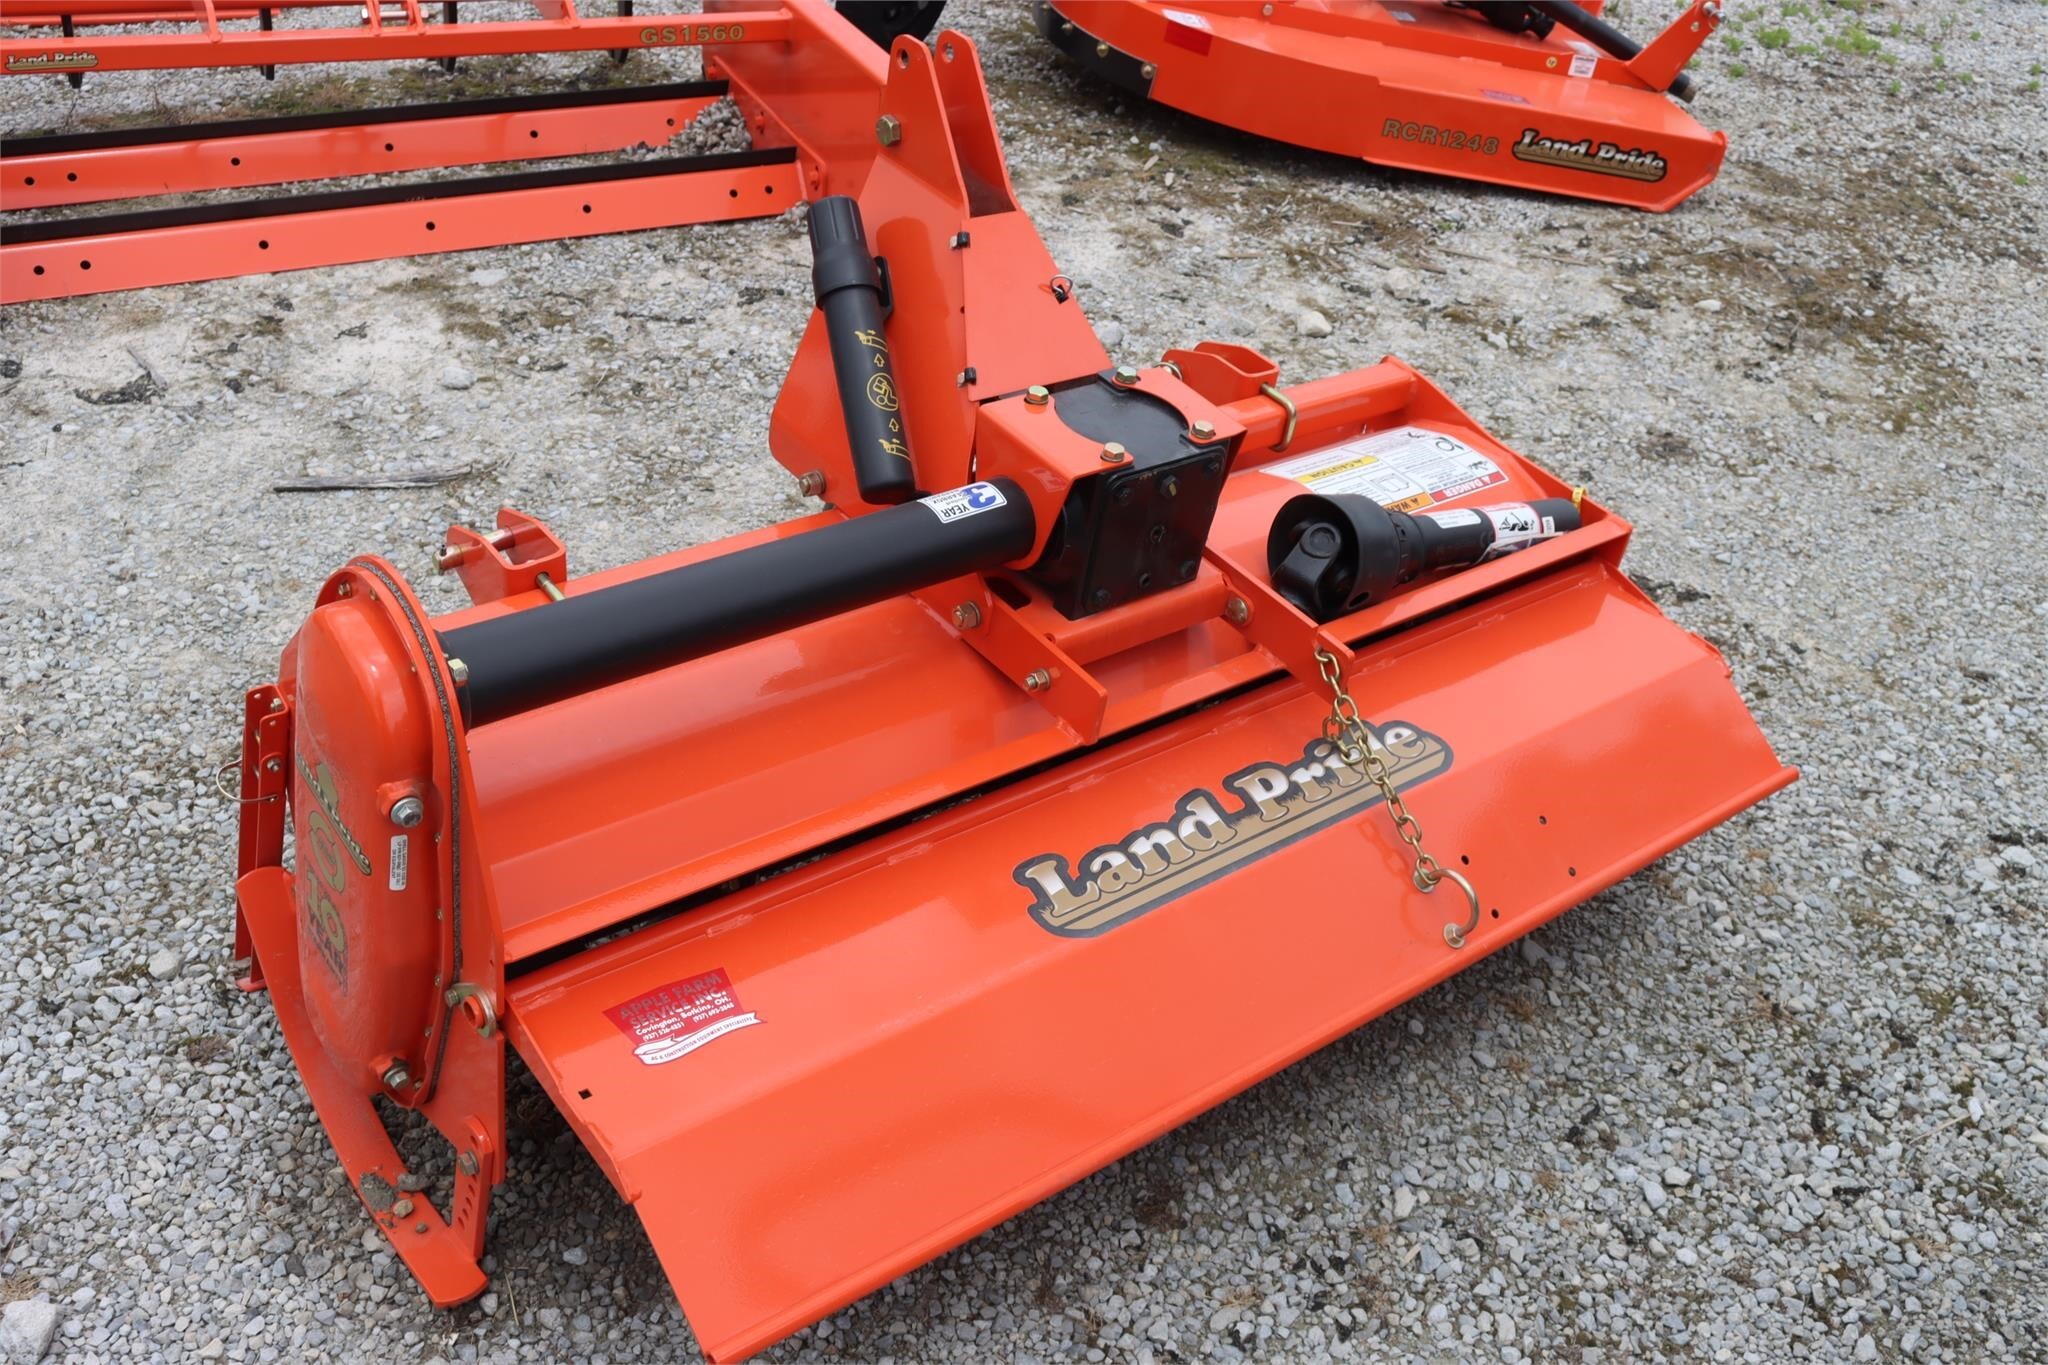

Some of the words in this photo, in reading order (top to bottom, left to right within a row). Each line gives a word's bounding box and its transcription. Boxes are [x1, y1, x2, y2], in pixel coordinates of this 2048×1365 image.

[640, 25, 744, 44] GS1560
[7, 54, 48, 66] Land
[54, 52, 97, 65] Pride
[1382, 118, 1500, 155] RCR1248
[1519, 129, 1588, 159] Land
[1592, 143, 1665, 176] Pride
[960, 484, 997, 509] 3
[1442, 476, 1484, 498] DANGER
[940, 503, 970, 518] YEAR
[1024, 795, 1238, 918] Land
[1233, 725, 1428, 824] Pride
[619, 992, 671, 1019] APPLE
[672, 973, 722, 999] FARM
[630, 998, 692, 1029] SERVICE
[694, 987, 727, 1006] INC.
[635, 1016, 681, 1036] Covington,
[681, 1004, 714, 1019] Botkins,
[714, 995, 732, 1006] OH.
